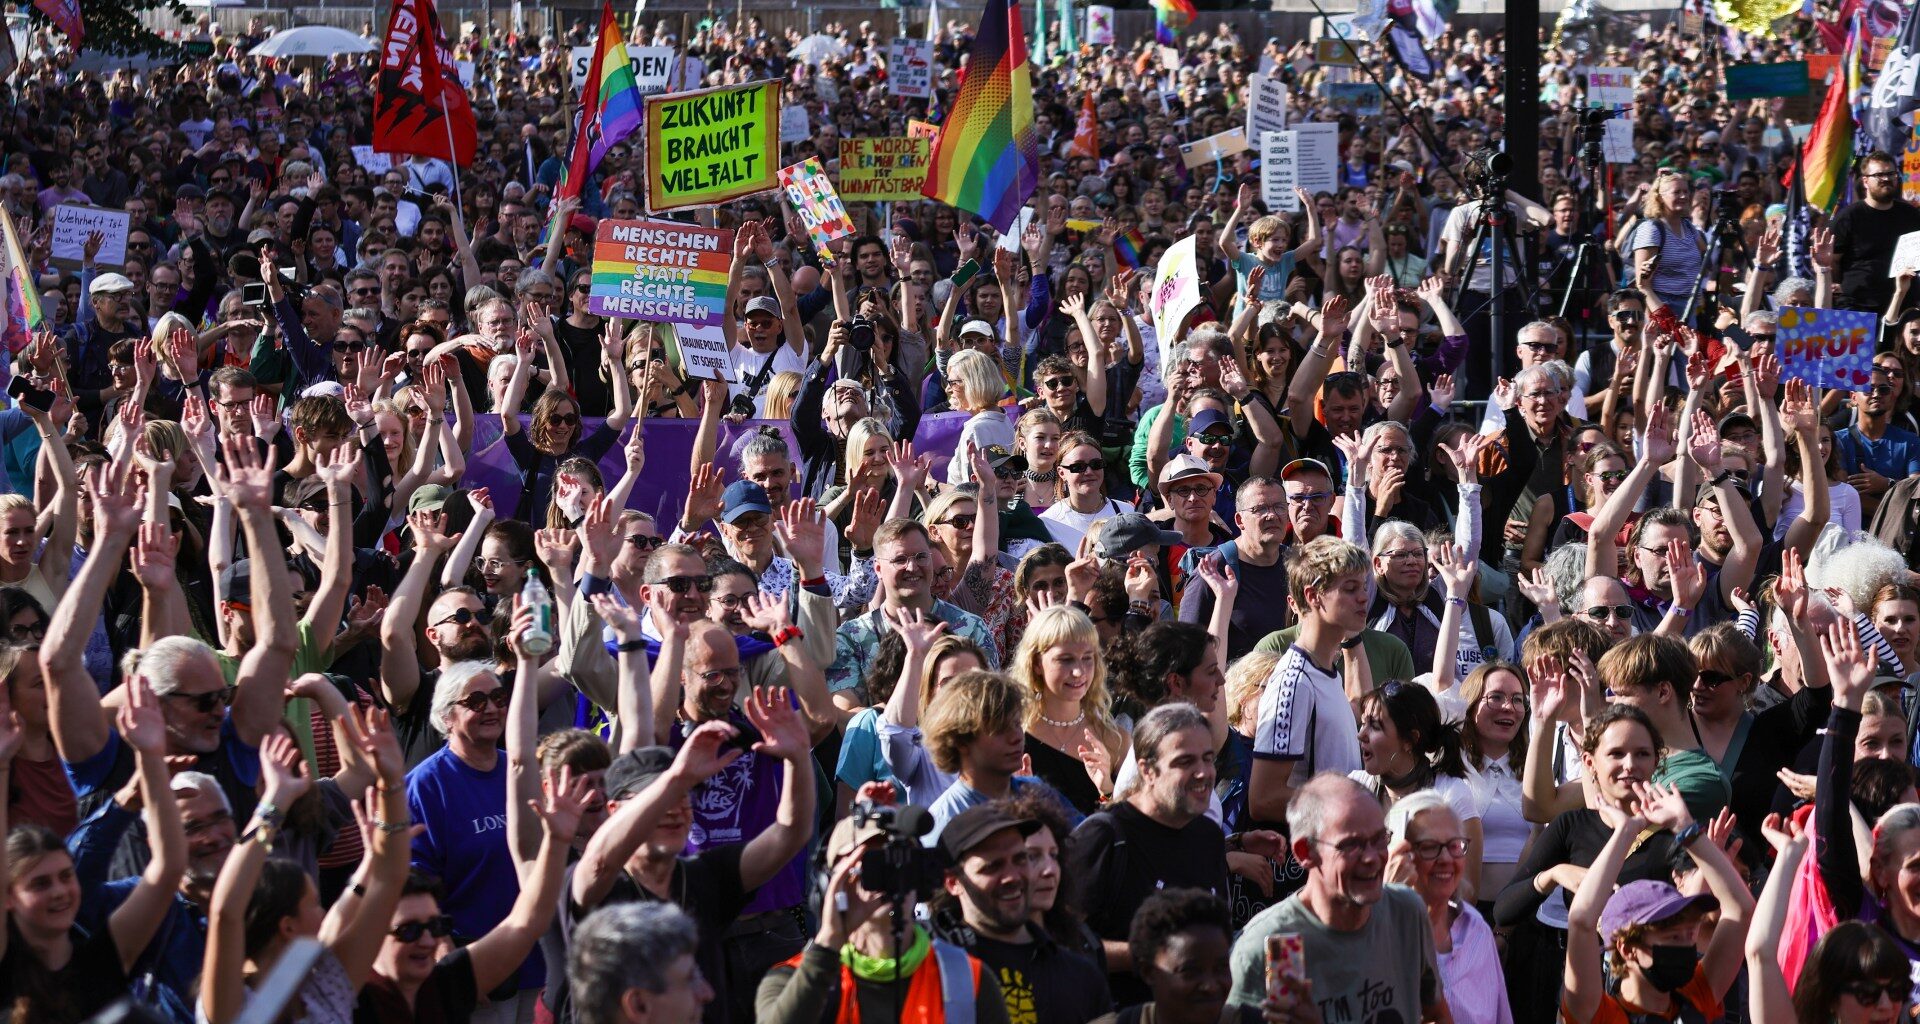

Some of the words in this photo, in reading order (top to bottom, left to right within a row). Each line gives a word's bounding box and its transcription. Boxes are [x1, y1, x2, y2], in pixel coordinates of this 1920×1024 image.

[576, 56, 667, 77] SDEN
[661, 86, 763, 129] ZUKUNFT
[668, 122, 755, 164] BRAUCHT
[840, 140, 865, 154] DIE
[1270, 146, 1289, 154] GEGEN
[661, 153, 759, 193] VIELFALT
[874, 168, 892, 178] IST
[786, 173, 834, 206] BLEIB
[57, 207, 104, 228] Wehrhaft
[797, 197, 845, 230] BUNT
[612, 226, 719, 250] MENSCHEN
[624, 245, 699, 267] RECHTE
[634, 265, 693, 284] STATT
[620, 279, 695, 302] RECHTE
[602, 296, 709, 320] MENSCHEN
[681, 336, 704, 350] BRAUNE
[704, 339, 727, 353] POLITIK
[1784, 327, 1869, 364] PRÜF
[691, 355, 700, 365] IST
[472, 815, 507, 834] LON
[1357, 978, 1394, 1020] too
